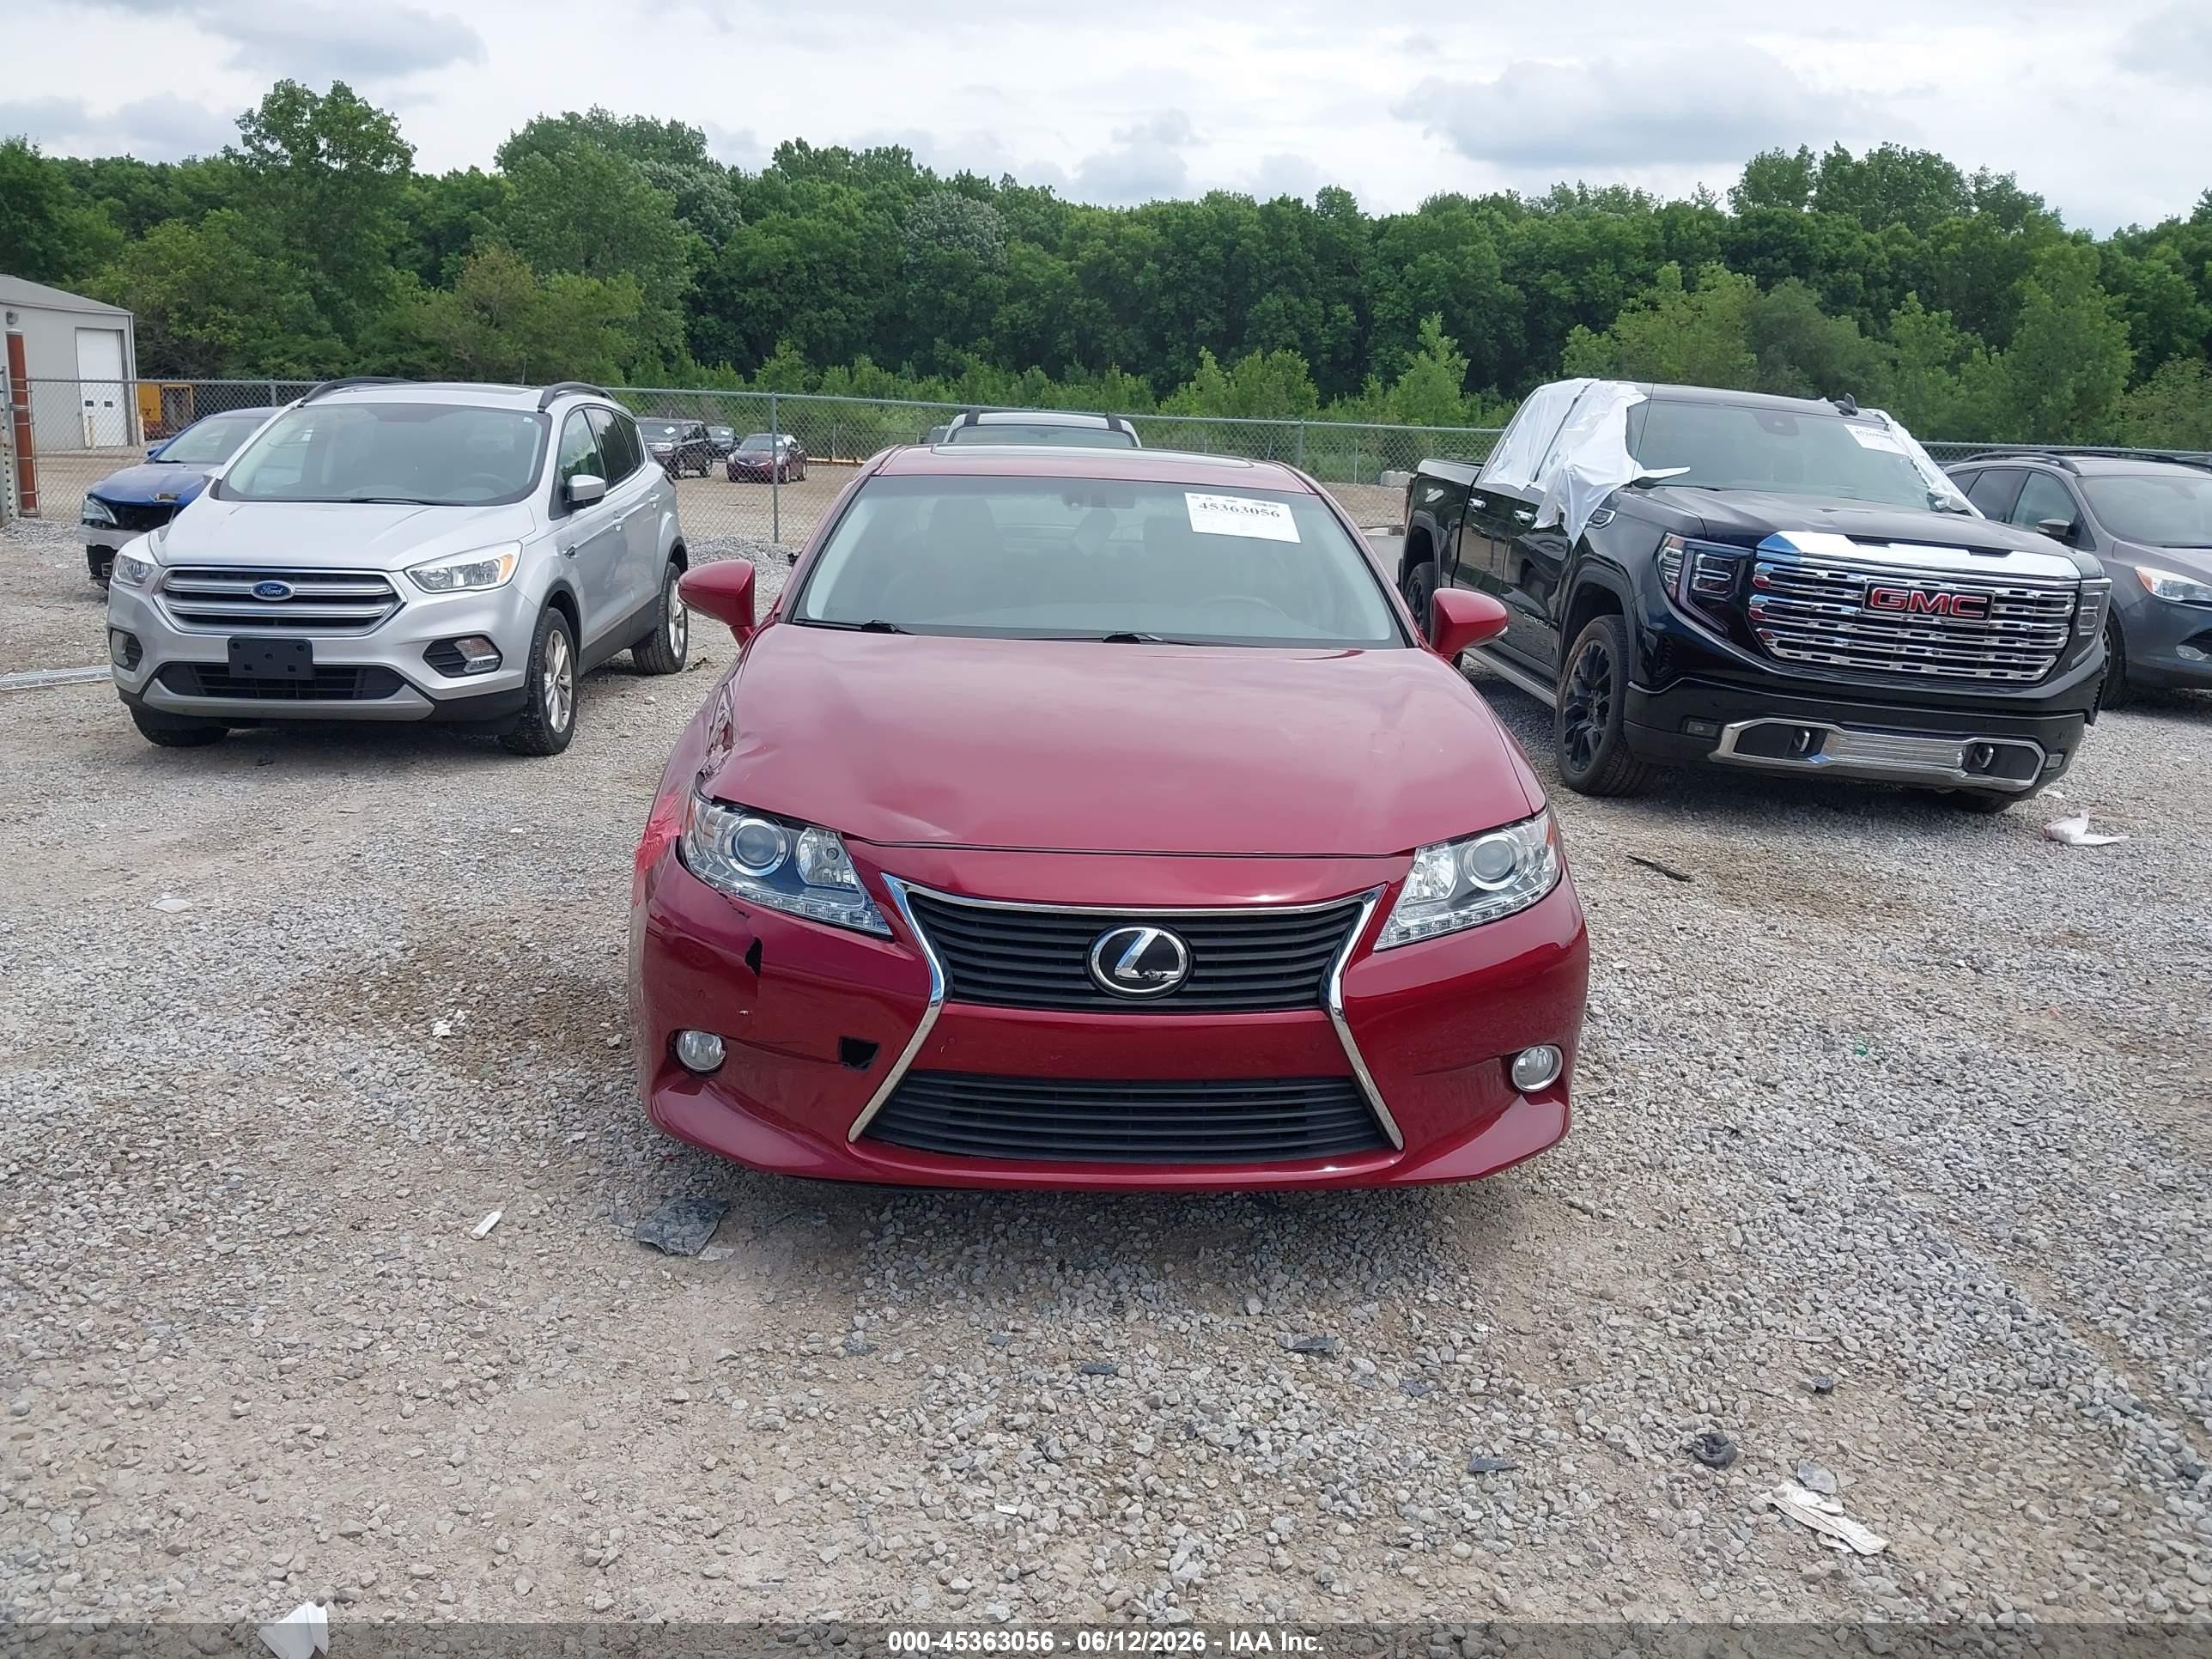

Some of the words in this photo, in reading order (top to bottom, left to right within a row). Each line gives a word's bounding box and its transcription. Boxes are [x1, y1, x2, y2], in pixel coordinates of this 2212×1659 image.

[1199, 502, 1280, 518] 45363056
[260, 585, 284, 595] Ford
[1870, 587, 1988, 617] GMC
